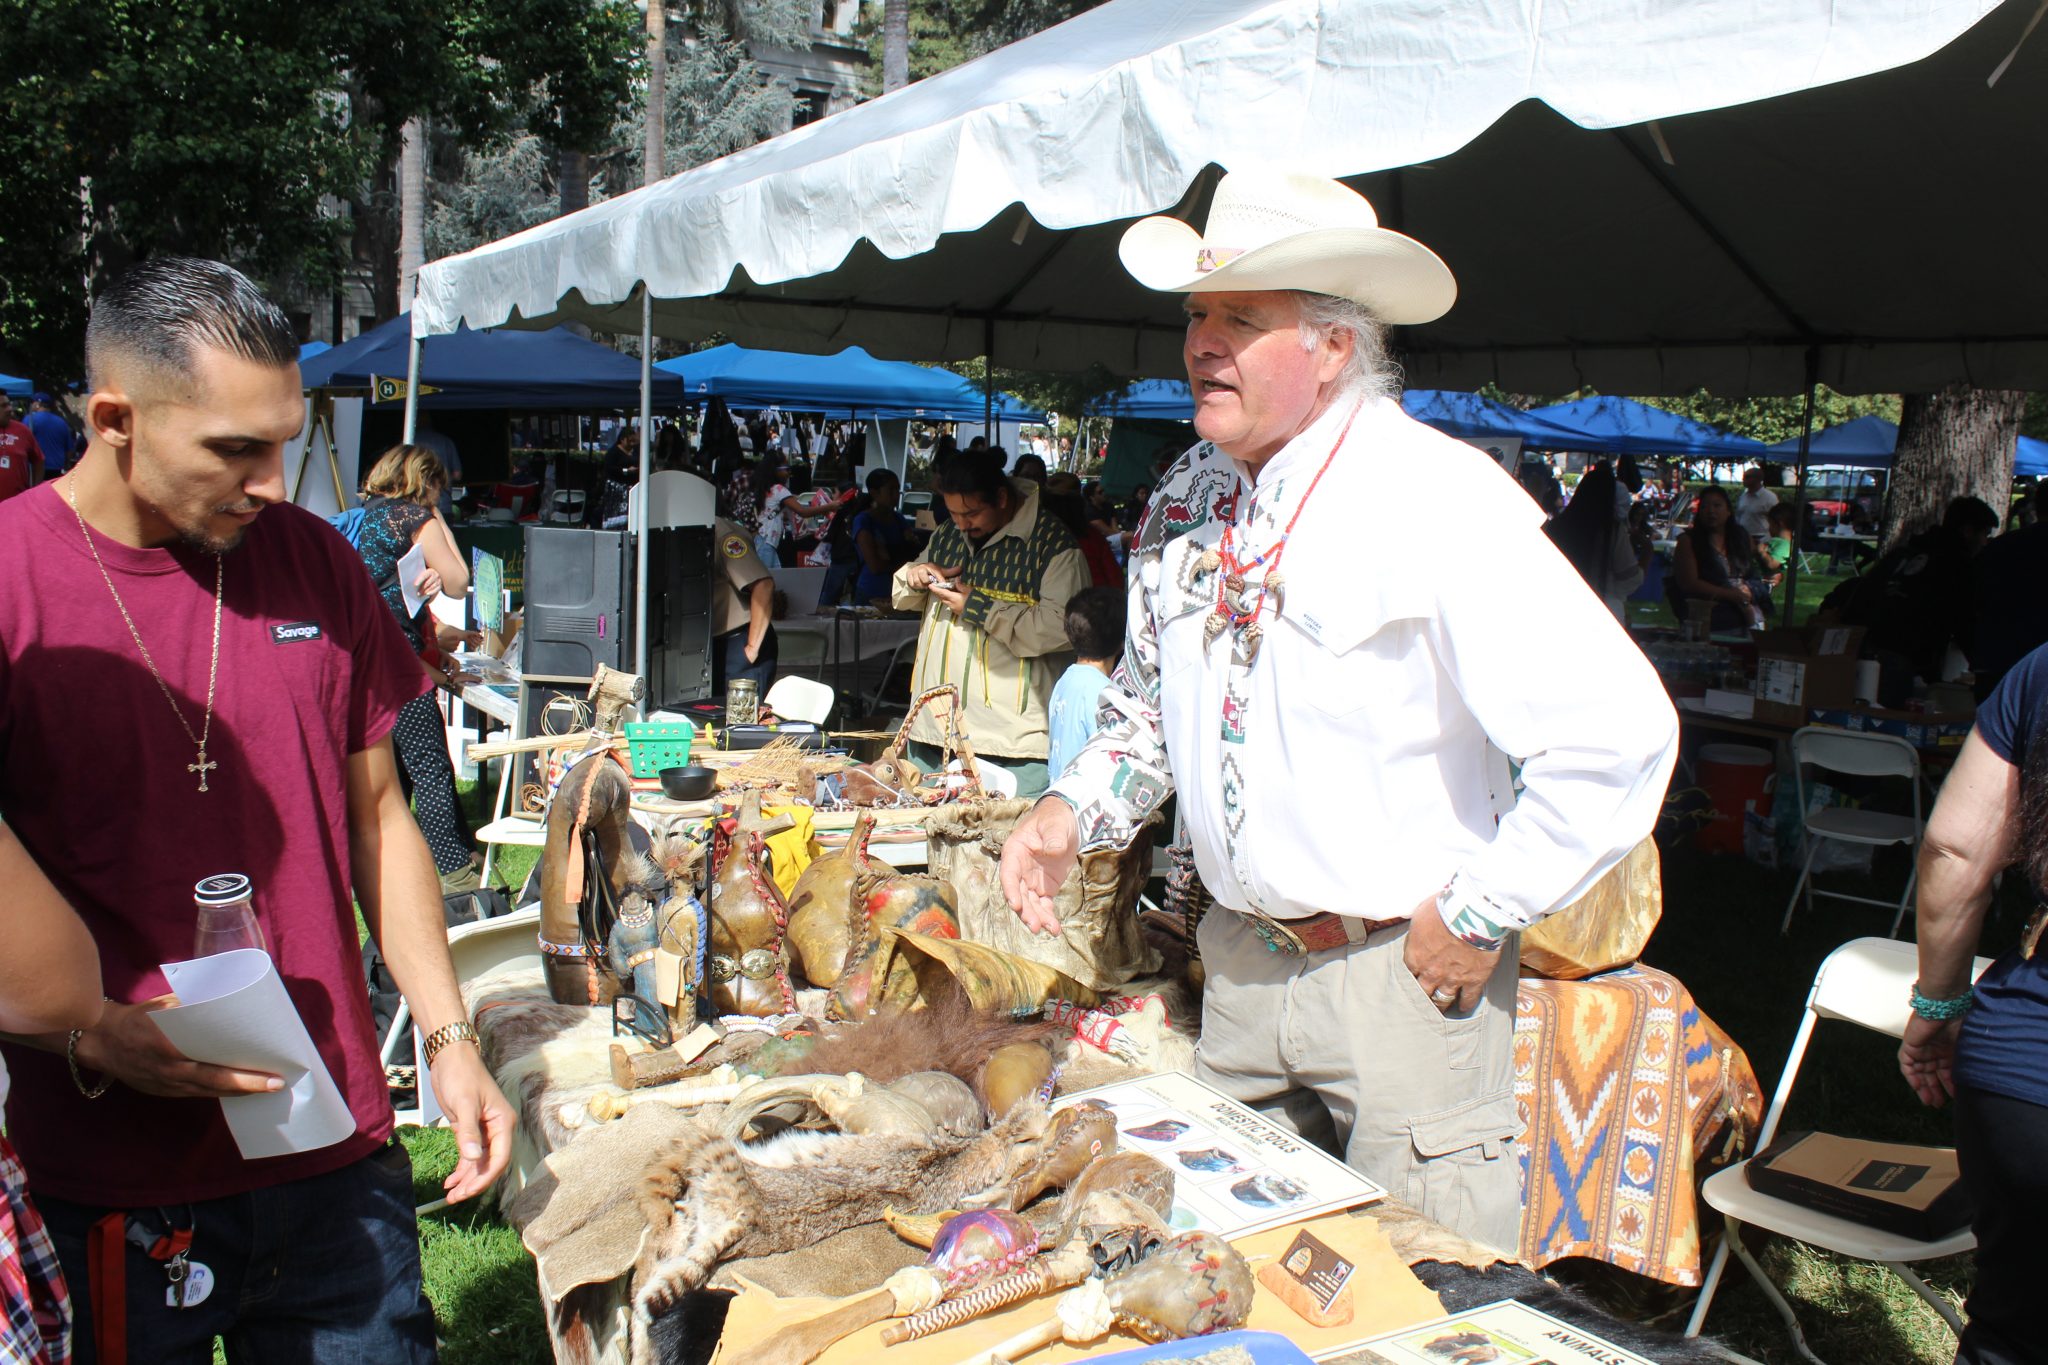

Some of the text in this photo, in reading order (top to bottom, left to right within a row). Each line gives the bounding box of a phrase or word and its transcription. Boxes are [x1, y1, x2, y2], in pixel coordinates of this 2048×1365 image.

[384, 385, 393, 394] H
[276, 626, 318, 639] Savage
[1210, 1103, 1267, 1132] DOMESTIC
[1260, 1131, 1301, 1153] TOOLS
[1541, 1330, 1625, 1365] ANIMALS
